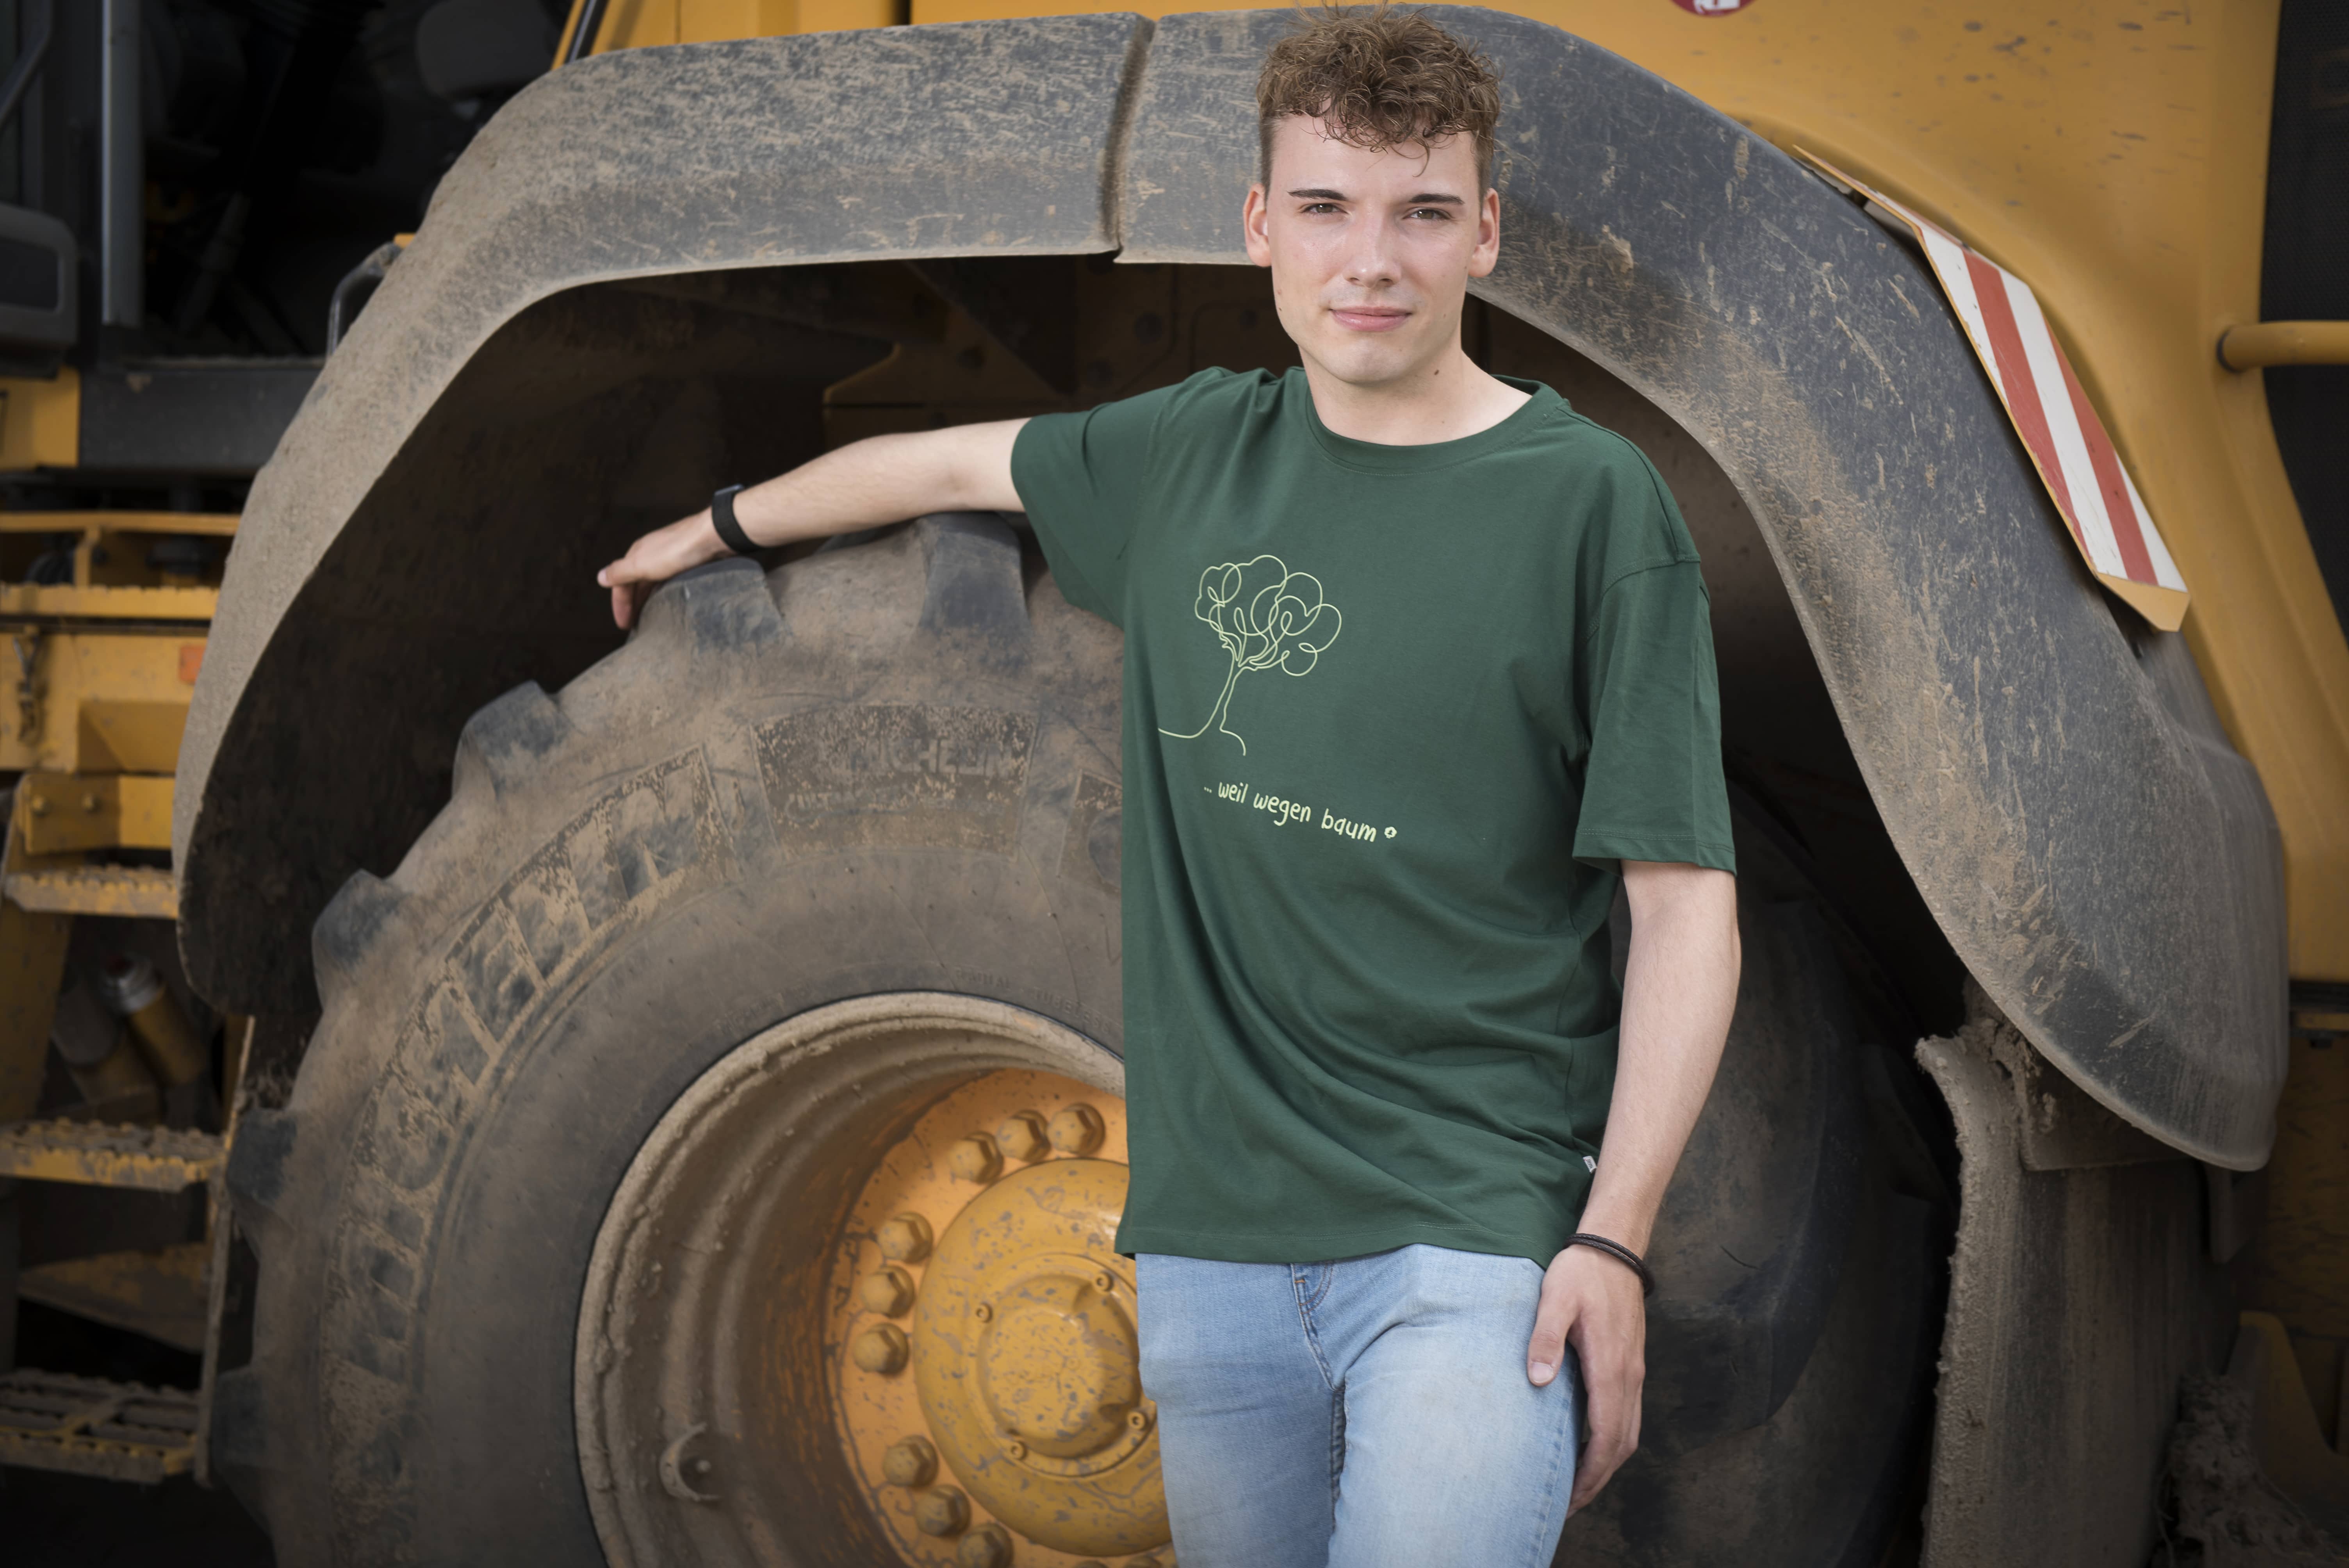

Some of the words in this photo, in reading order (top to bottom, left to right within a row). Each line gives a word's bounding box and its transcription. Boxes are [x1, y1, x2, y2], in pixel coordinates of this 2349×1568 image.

[1218, 782, 1249, 804] weil
[1253, 793, 1311, 826] wegen
[1321, 807, 1377, 843] baum
[1032, 986, 1111, 1035] TUBELESS
